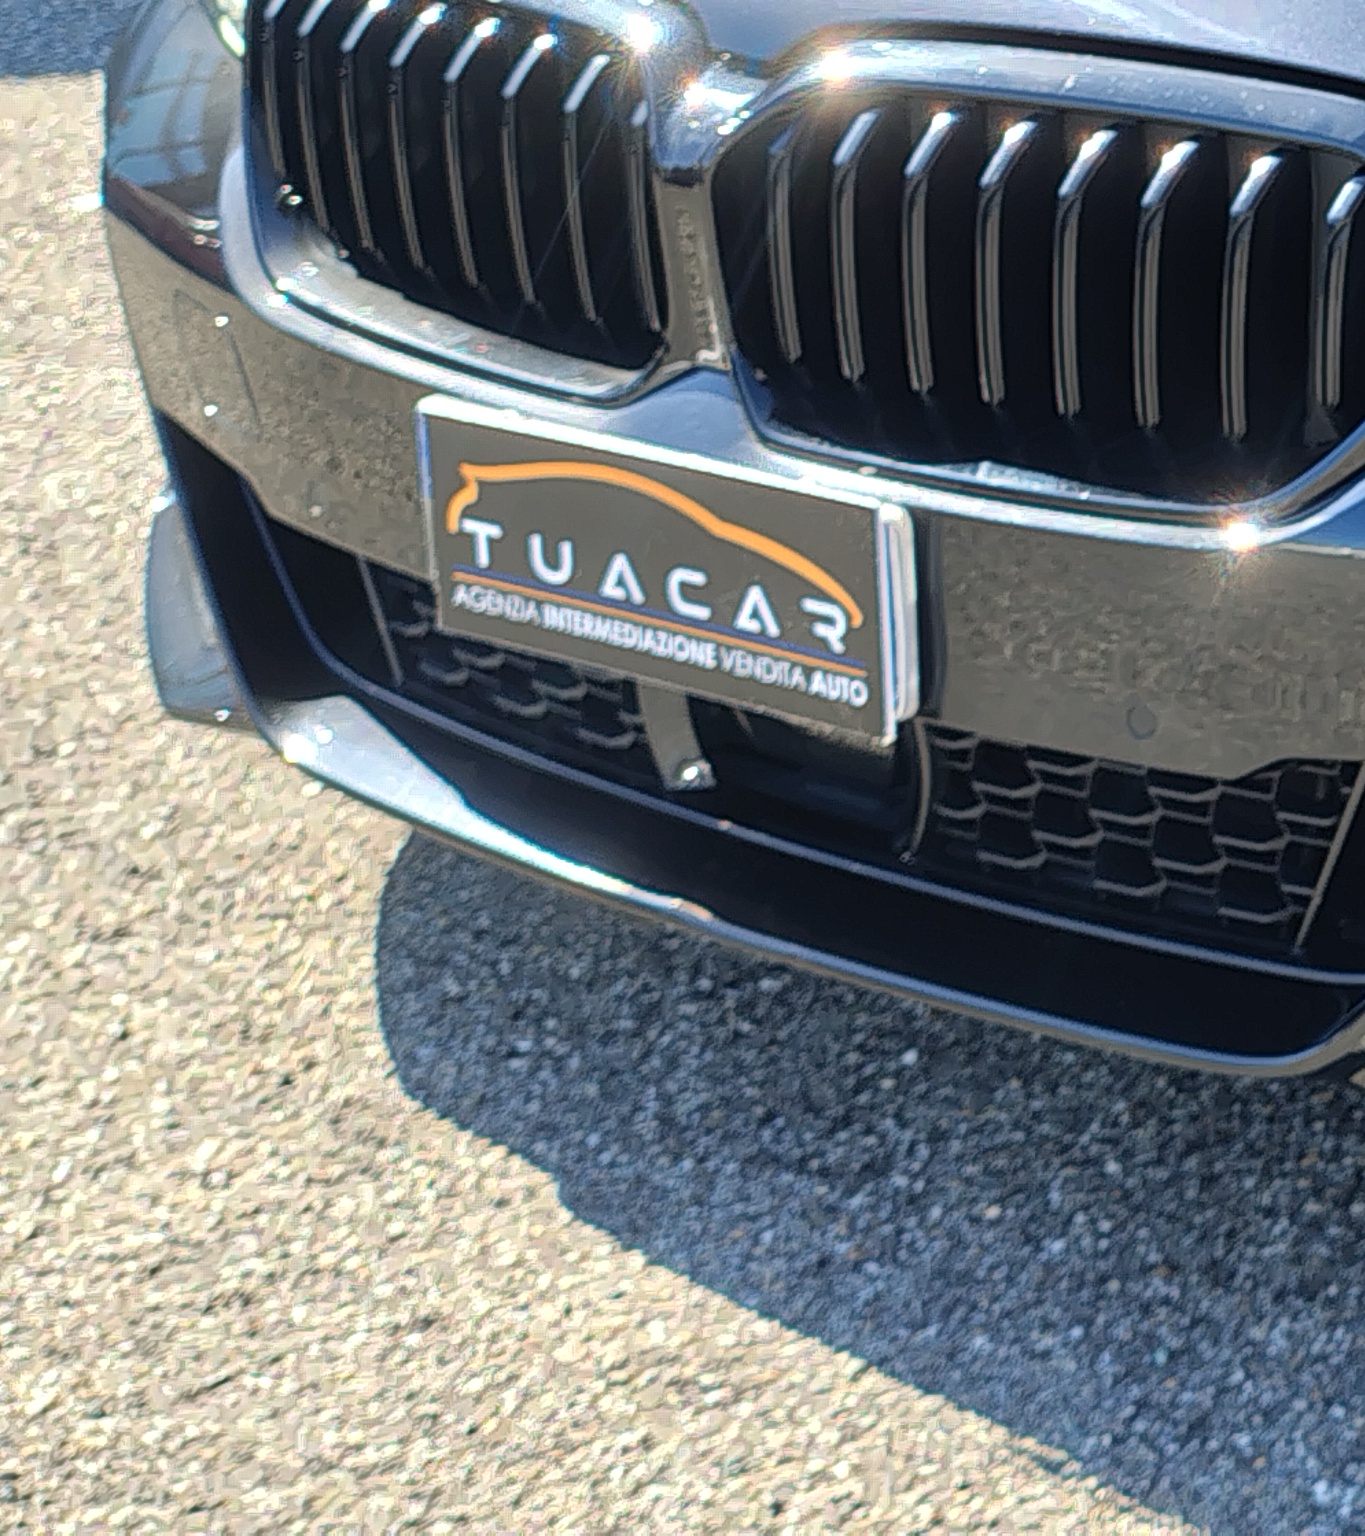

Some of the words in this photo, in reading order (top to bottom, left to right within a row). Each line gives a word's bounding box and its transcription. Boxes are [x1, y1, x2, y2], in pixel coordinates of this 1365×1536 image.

[451, 584, 540, 632] AGENZIA
[540, 602, 717, 672] INTERMEDIAZIONE
[718, 643, 808, 695] VENDITA
[808, 666, 870, 709] AUTO
[459, 517, 848, 655] TUACAR
